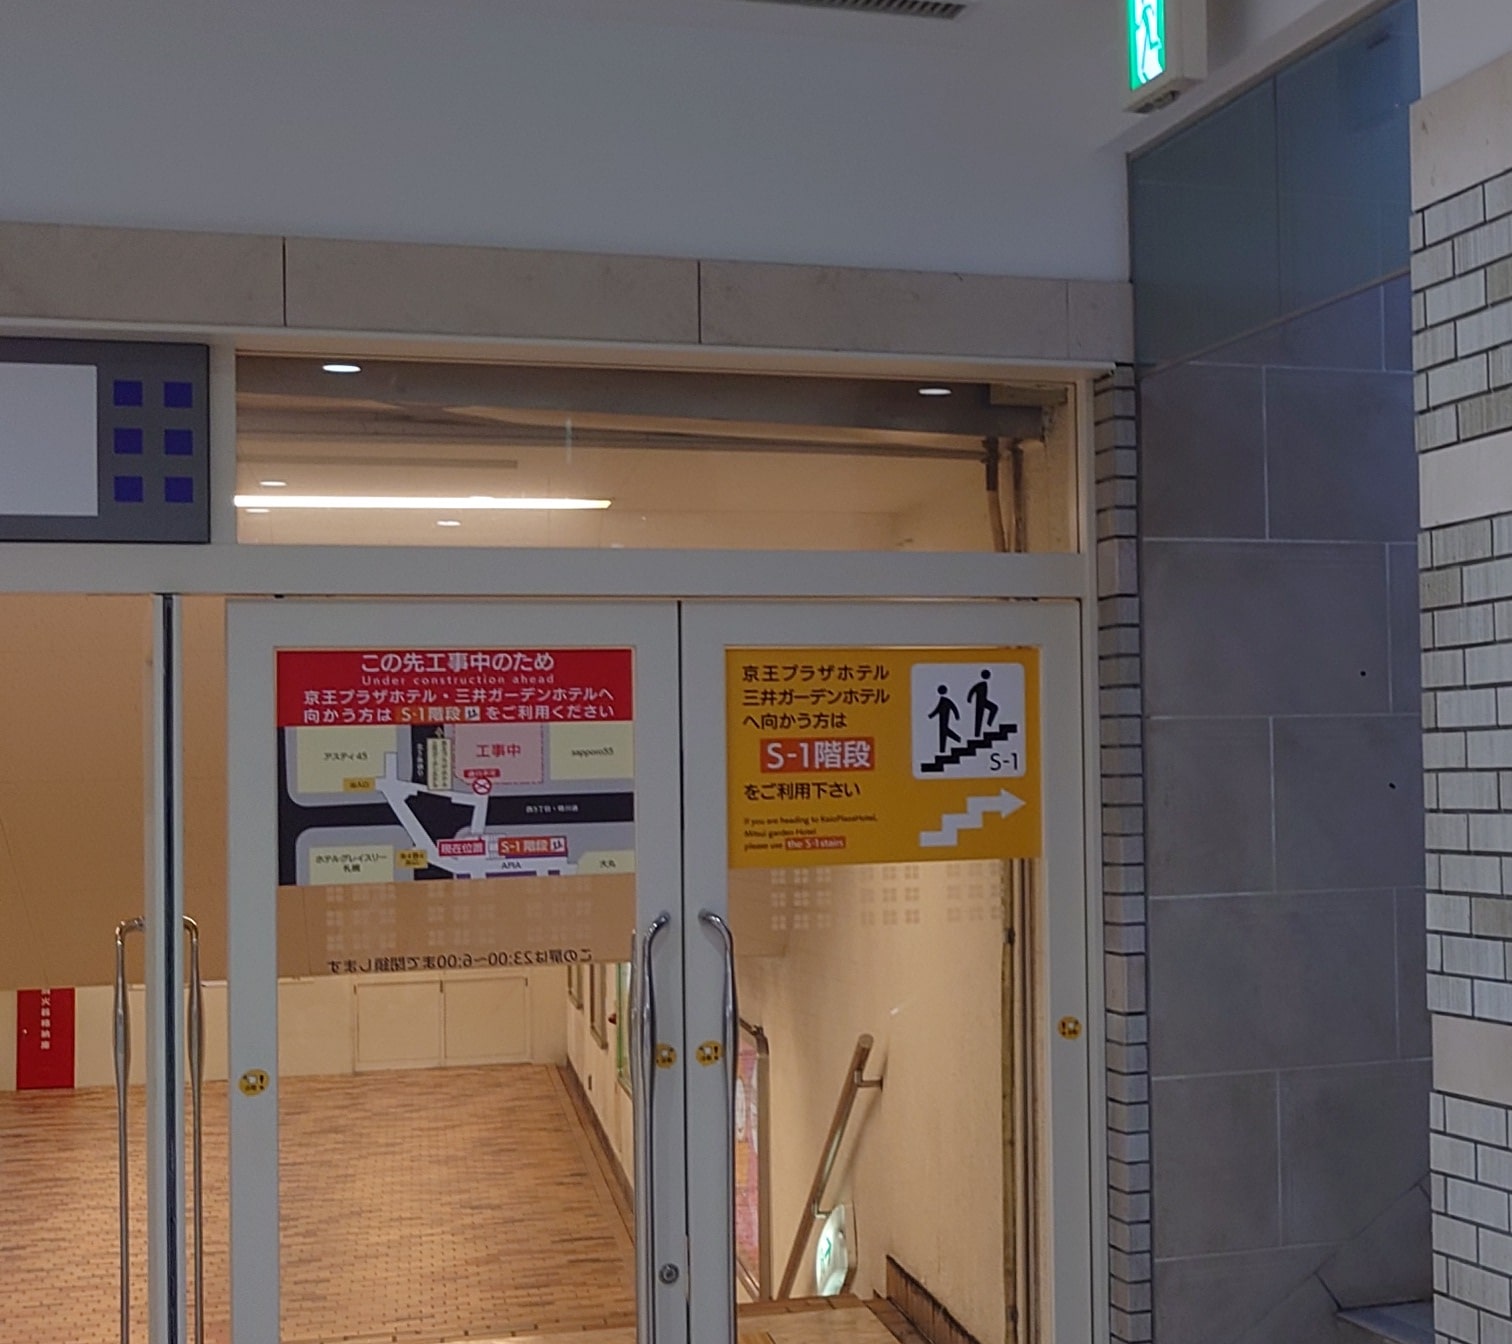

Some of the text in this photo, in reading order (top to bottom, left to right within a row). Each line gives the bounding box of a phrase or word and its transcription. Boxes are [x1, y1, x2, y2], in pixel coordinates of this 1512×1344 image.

[361, 652, 555, 673] この先工事中のため
[362, 674, 555, 685] Under construction ahead
[742, 665, 889, 682] 京王プラザホテル
[742, 689, 890, 706] 三井ガーデンホテル
[304, 708, 392, 724] 向かう方は
[486, 704, 614, 720] をご利用ください
[743, 712, 847, 730] へ向かう方は
[475, 744, 521, 758] 工事中
[767, 740, 871, 770] S-1階段
[990, 752, 1018, 771] S-1
[744, 782, 861, 800] をご利用下さい
